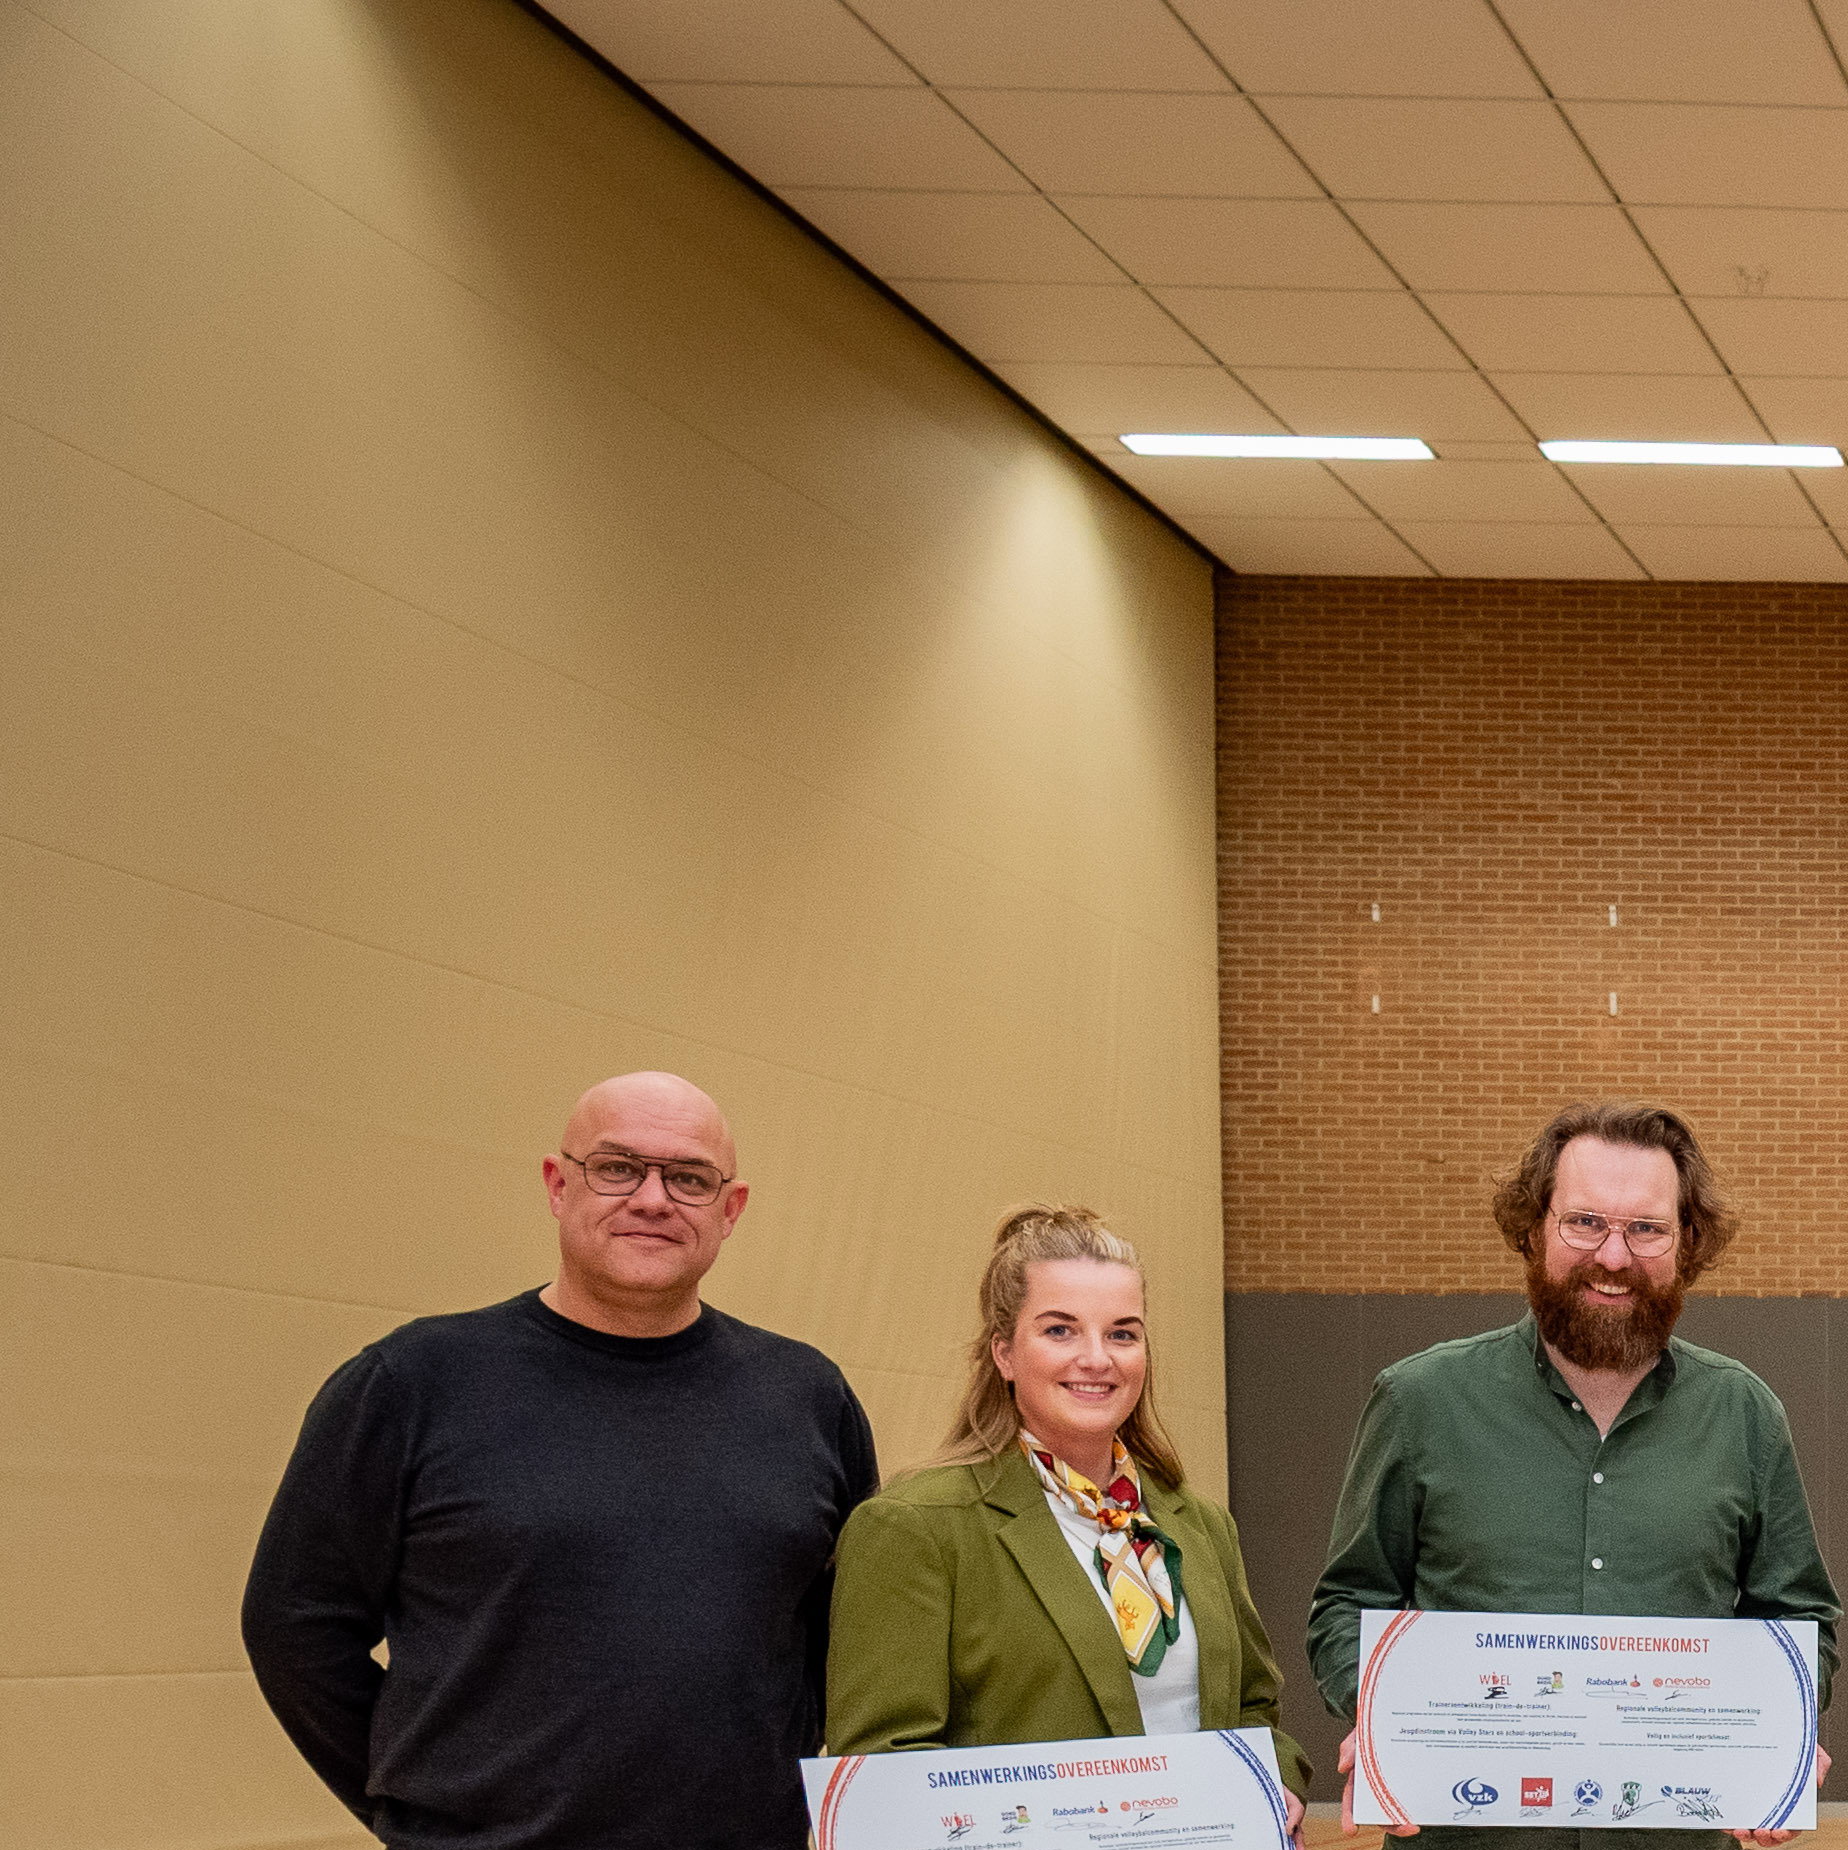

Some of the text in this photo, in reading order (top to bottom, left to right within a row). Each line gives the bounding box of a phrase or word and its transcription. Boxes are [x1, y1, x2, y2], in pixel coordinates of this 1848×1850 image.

[1475, 1633, 1709, 1653] SAMENWERKINGSOVEREENKOMST
[1586, 1677, 1627, 1686] Rabobank
[1665, 1676, 1710, 1686] nevobo
[926, 1755, 1170, 1789] SAMENWERKINGSOVEREENKOMST
[1675, 1787, 1711, 1795] BLAUW
[1468, 1792, 1493, 1802] vzk
